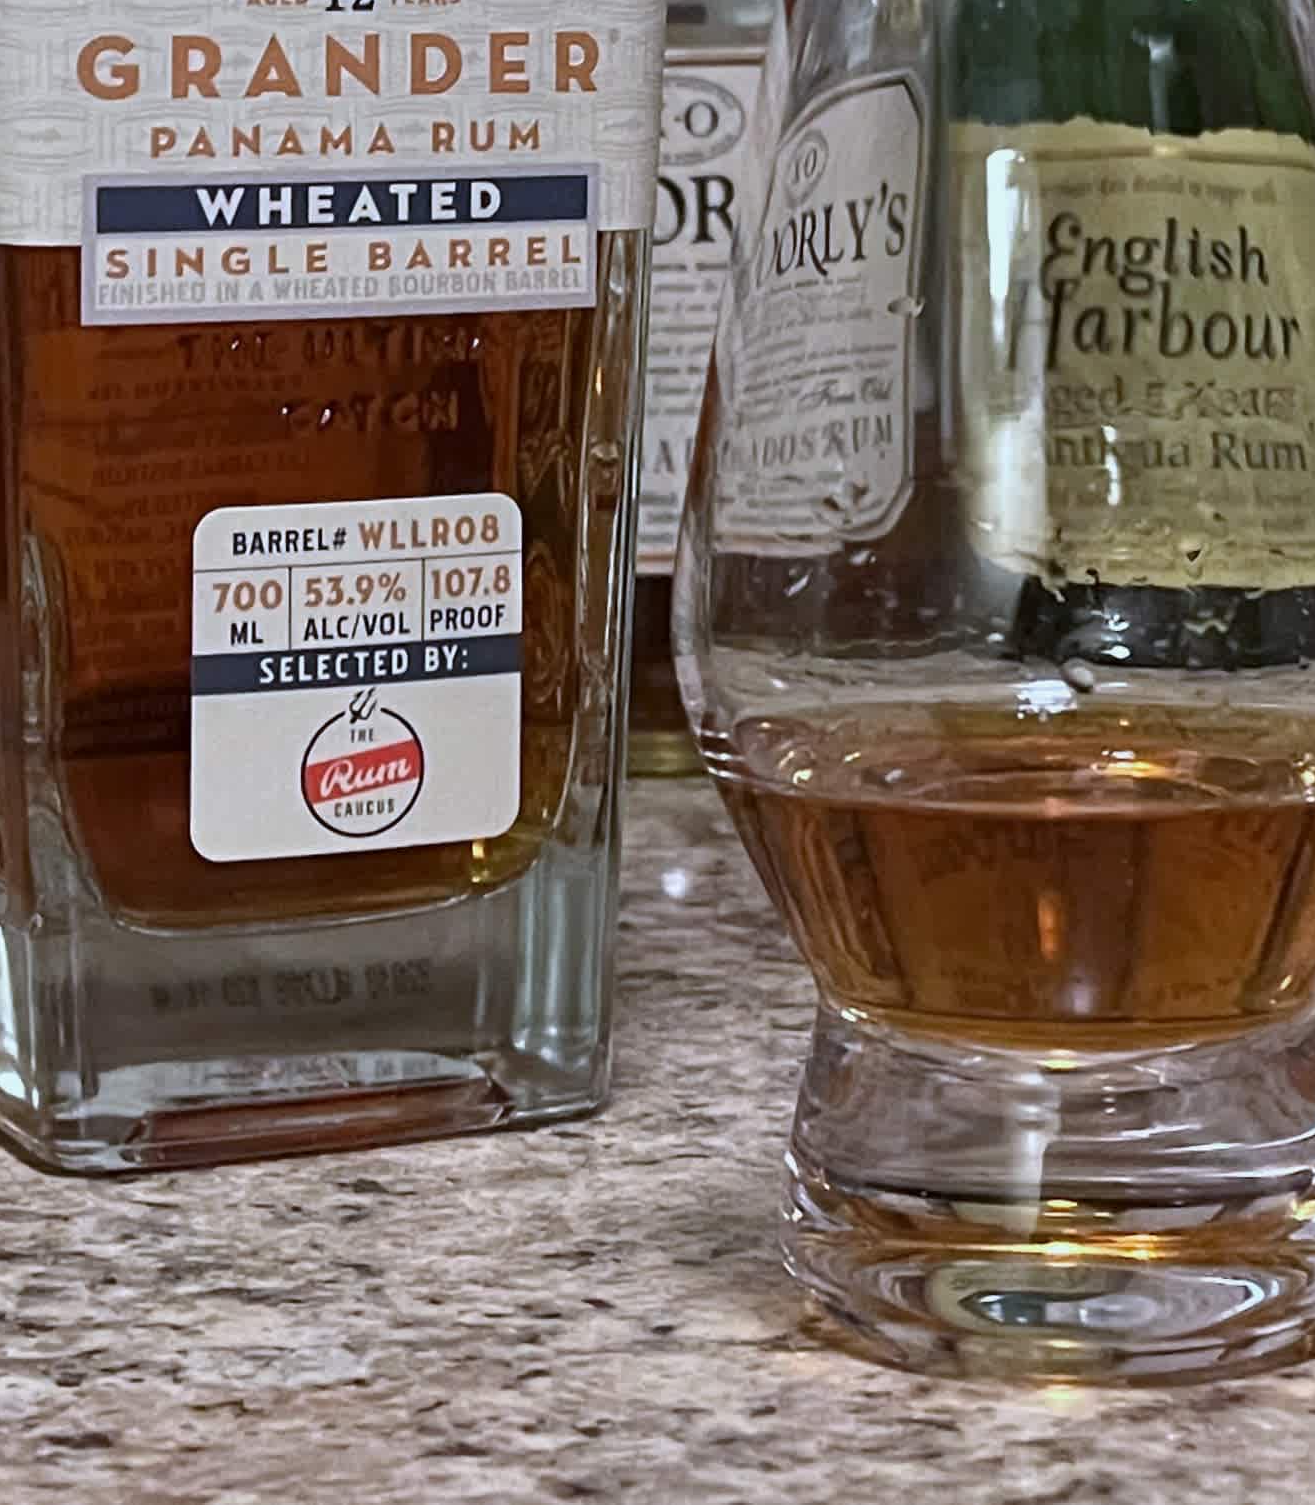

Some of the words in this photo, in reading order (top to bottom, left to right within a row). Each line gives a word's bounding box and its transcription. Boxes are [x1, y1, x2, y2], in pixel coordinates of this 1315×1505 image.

[75, 30, 601, 101] GRANDER
[149, 120, 397, 159] PANAMA
[431, 119, 542, 154] RUM
[196, 180, 502, 228] WHEATED
[105, 241, 329, 280] SINGLE
[368, 233, 582, 271] BARREL
[1040, 211, 1270, 301] English
[97, 276, 208, 307] FINISHED
[216, 278, 240, 304] IN
[245, 279, 264, 303] A
[272, 274, 379, 302] WHEATED
[387, 270, 498, 298] BOURBON
[504, 267, 583, 293] BARREL
[1210, 430, 1308, 472] Rum
[231, 526, 347, 557] BARREL#
[212, 578, 283, 614] 700
[303, 571, 407, 608] 53.9%
[431, 564, 513, 601] 107.8
[229, 620, 265, 646] ML
[302, 611, 411, 642] ALC/VOL
[429, 603, 507, 632] PROOF
[259, 651, 410, 685] SELECTED
[424, 645, 470, 673] BY:
[349, 728, 375, 744] THE
[318, 755, 413, 800] Rum
[333, 798, 396, 819] CAUCUS
